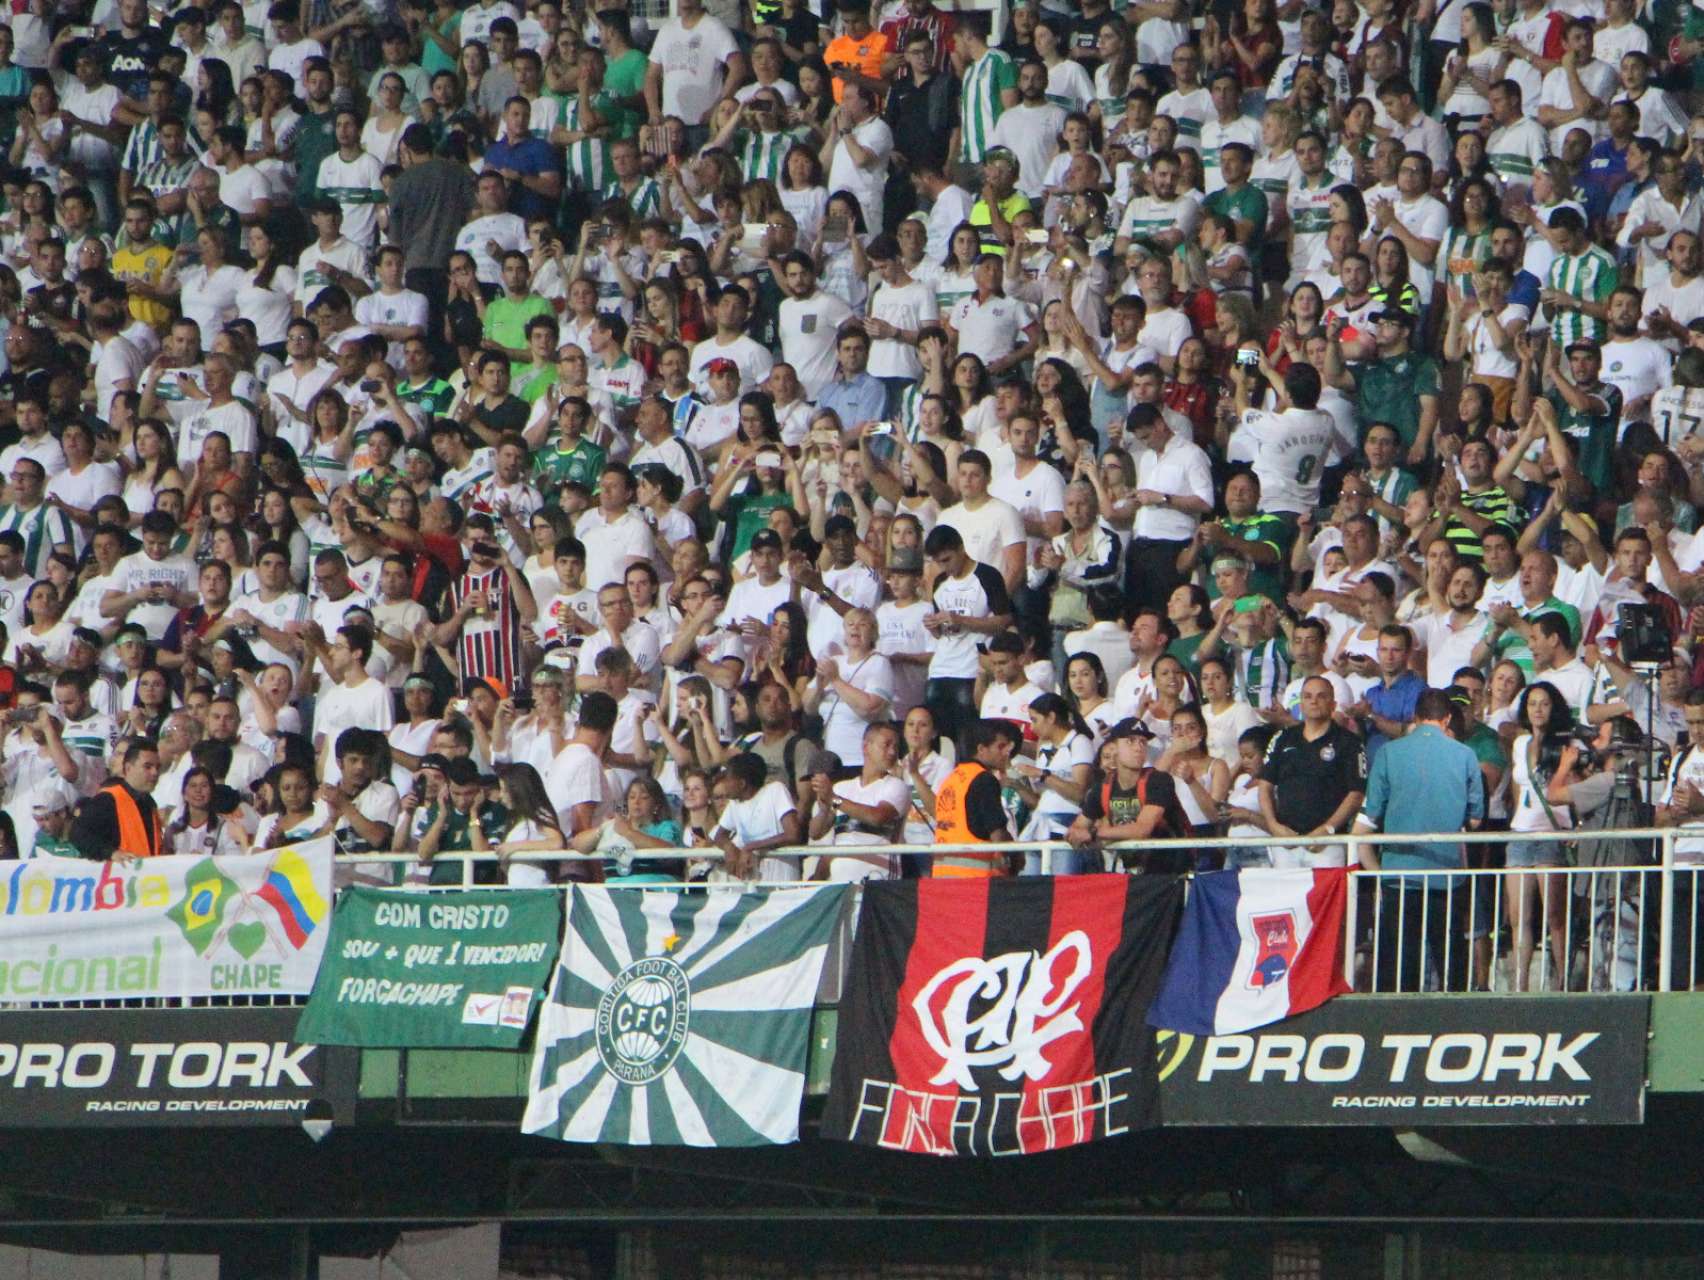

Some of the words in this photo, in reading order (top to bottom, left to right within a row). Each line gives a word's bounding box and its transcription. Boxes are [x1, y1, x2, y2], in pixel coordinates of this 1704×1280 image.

[1294, 454, 1317, 485] 8
[374, 902, 420, 928] COM
[428, 904, 510, 930] CRISTO
[342, 940, 381, 959] SOU
[403, 943, 444, 968] QUE
[445, 940, 461, 965] 1
[210, 963, 283, 990] CHAPE
[636, 960, 668, 977] FOOT
[672, 1000, 688, 1043] CLUB
[617, 1003, 667, 1036] CFC
[129, 1041, 318, 1088] TORK
[1197, 1032, 1366, 1083] PRO
[1381, 1032, 1600, 1083] TORK
[86, 1100, 161, 1112] RACING
[165, 1099, 310, 1112] DEVELOPMENT
[1331, 1095, 1417, 1109] RACING
[1422, 1094, 1592, 1109] DEVELOPMENT
